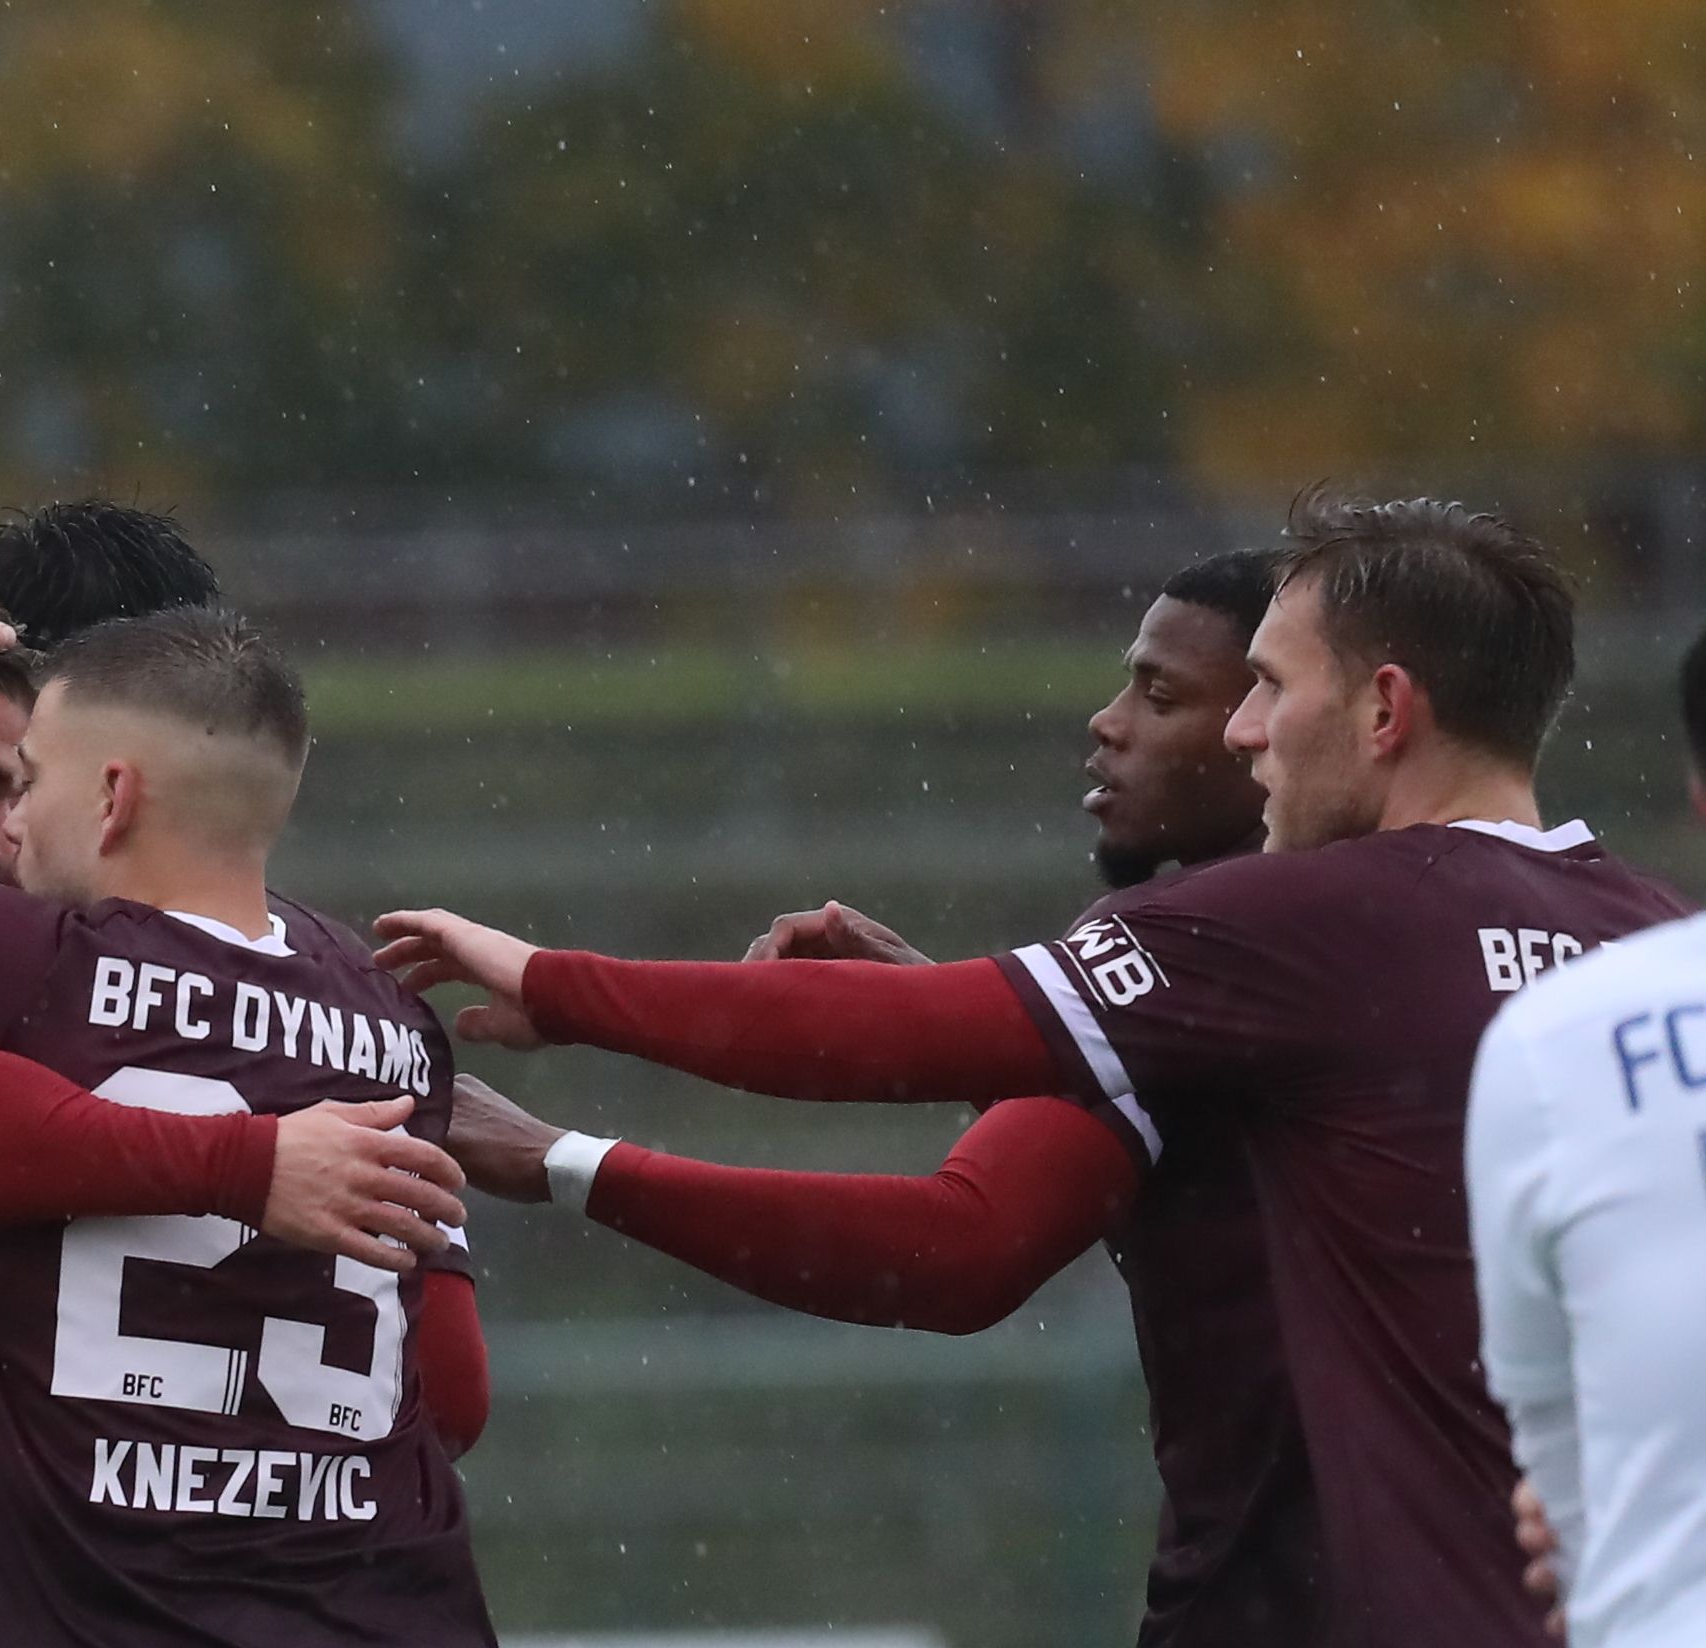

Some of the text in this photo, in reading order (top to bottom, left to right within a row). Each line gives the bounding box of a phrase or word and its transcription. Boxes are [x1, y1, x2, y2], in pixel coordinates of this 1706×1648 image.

[88, 956, 432, 1098] BFC DYNAMO
[122, 1373, 164, 1399] BFC
[329, 1403, 363, 1432] BFC
[88, 1438, 377, 1522] KNEZEVIC
